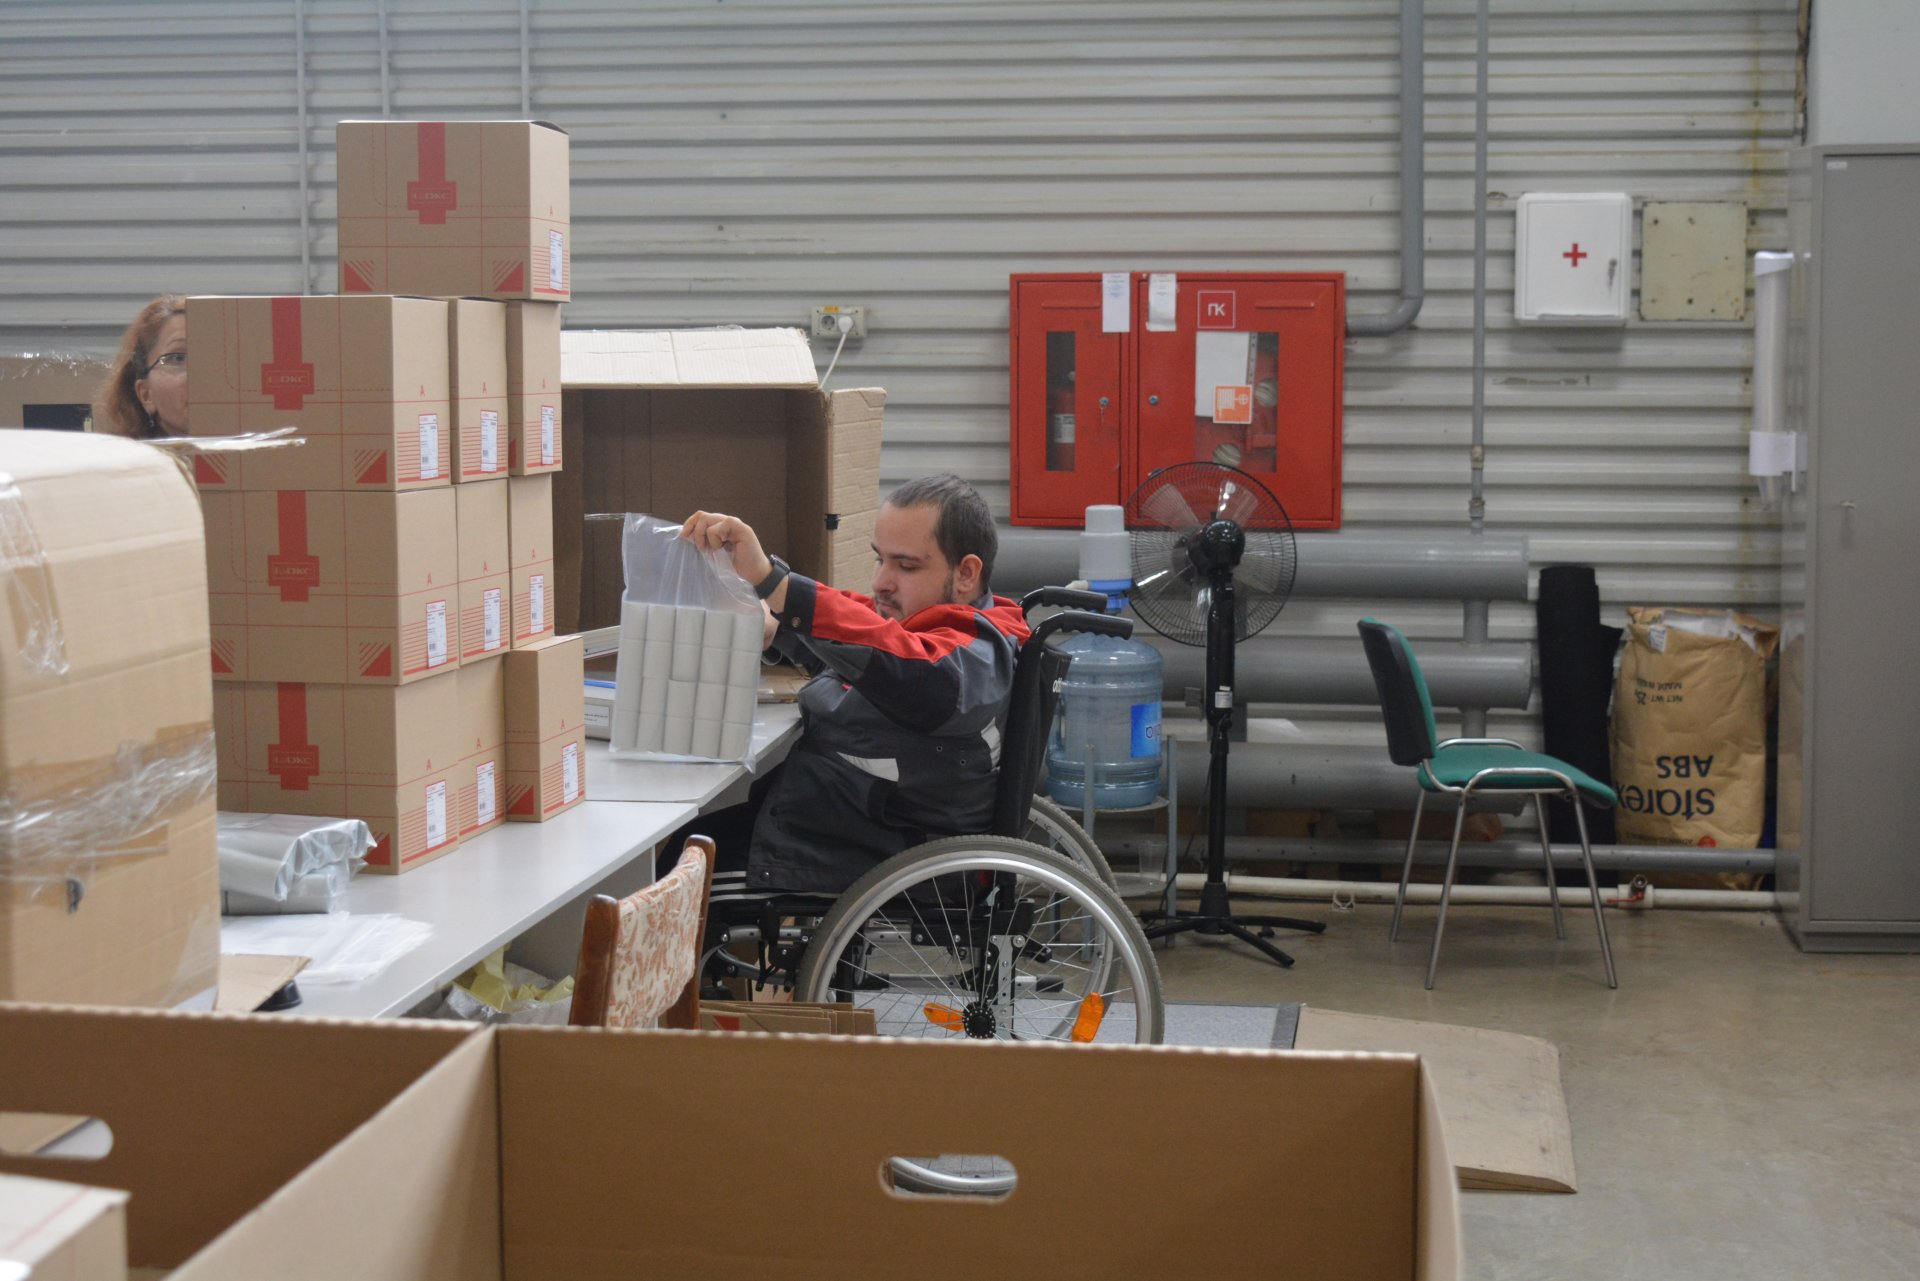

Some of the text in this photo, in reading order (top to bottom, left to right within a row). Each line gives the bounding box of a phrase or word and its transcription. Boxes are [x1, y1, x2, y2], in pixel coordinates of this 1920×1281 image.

[1207, 302, 1226, 317] ПК
[419, 384, 426, 397] A
[426, 572, 433, 585] A
[1666, 695, 1683, 703] NET
[560, 719, 566, 730] A
[476, 737, 482, 749] A
[426, 758, 432, 770] A
[1656, 755, 1714, 779] ABS
[1615, 782, 1716, 821] starex
